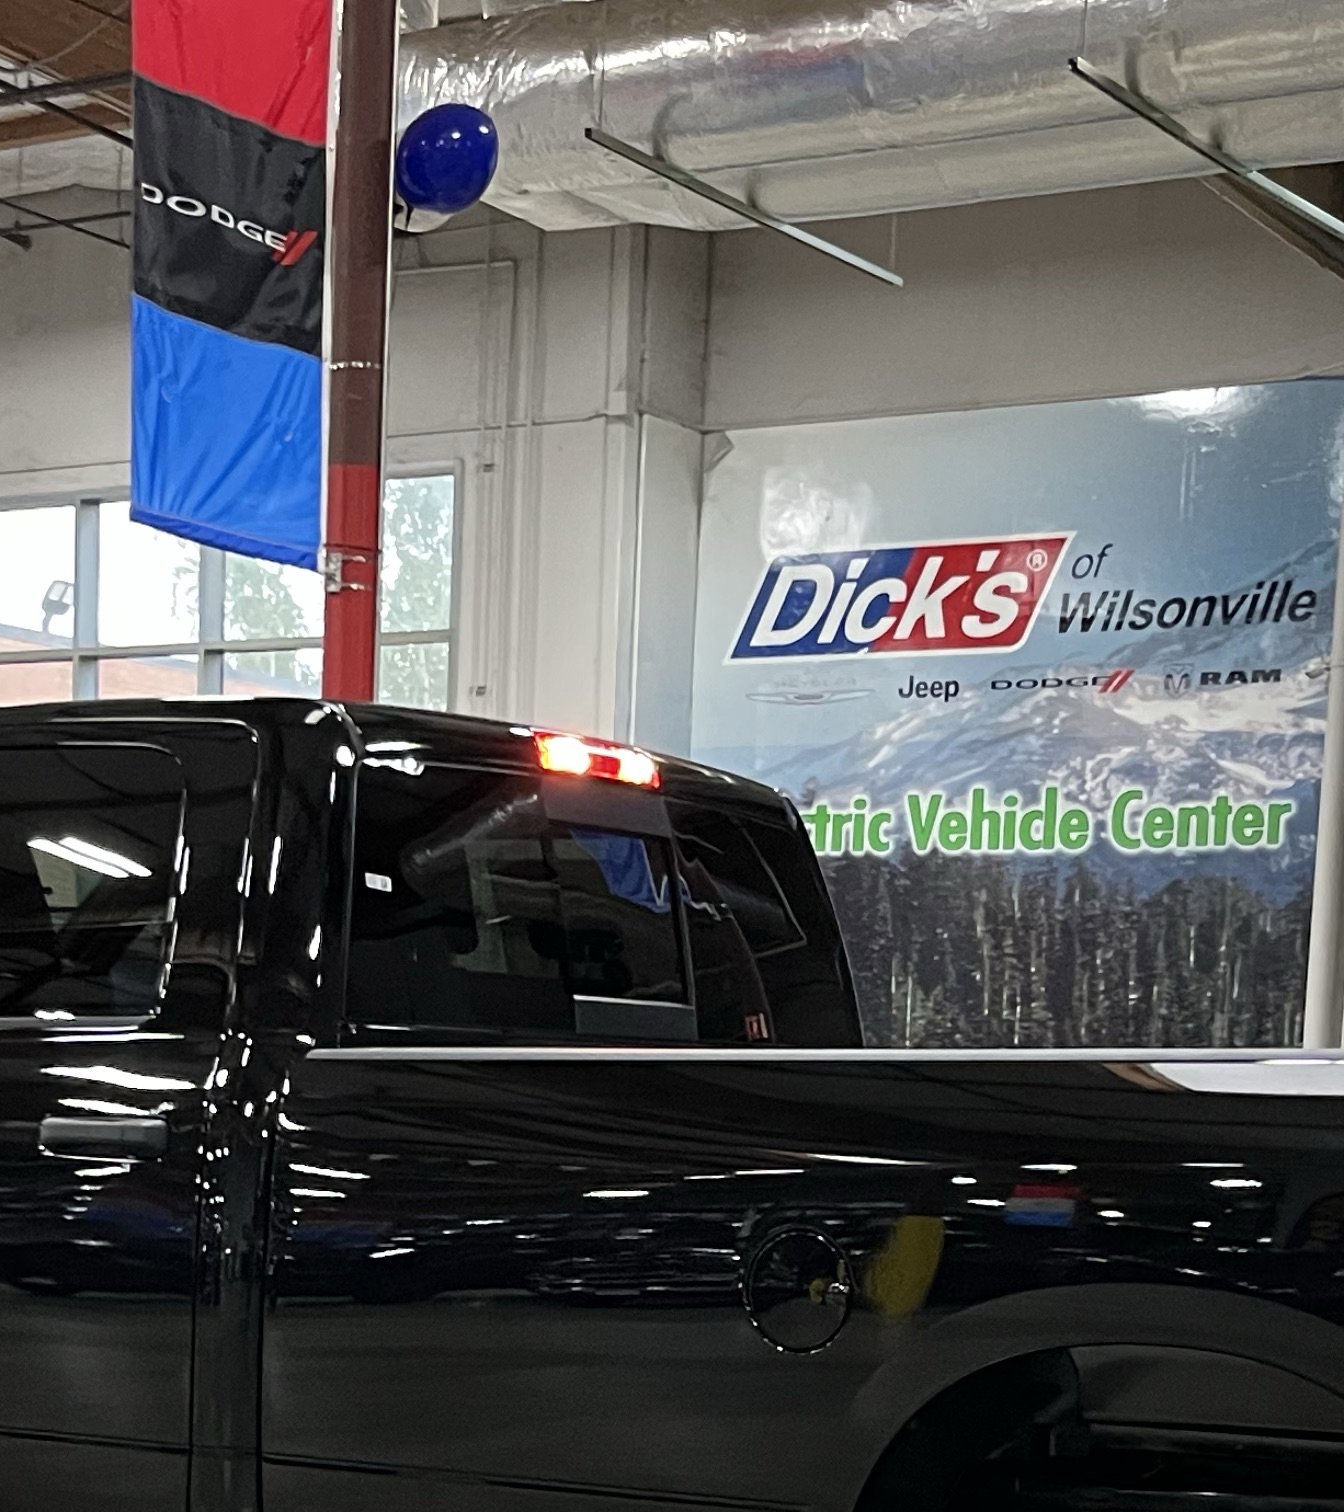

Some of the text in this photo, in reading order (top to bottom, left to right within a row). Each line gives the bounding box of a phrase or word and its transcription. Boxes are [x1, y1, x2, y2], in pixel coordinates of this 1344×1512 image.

[140, 182, 288, 253] DODGE
[1072, 543, 1113, 579] of
[749, 549, 1029, 647] Dick's
[1058, 579, 1317, 633] Wilsonville
[898, 675, 960, 702] Jeep
[1199, 668, 1282, 686] RAM
[802, 786, 1292, 851] tric Vehicle Center
